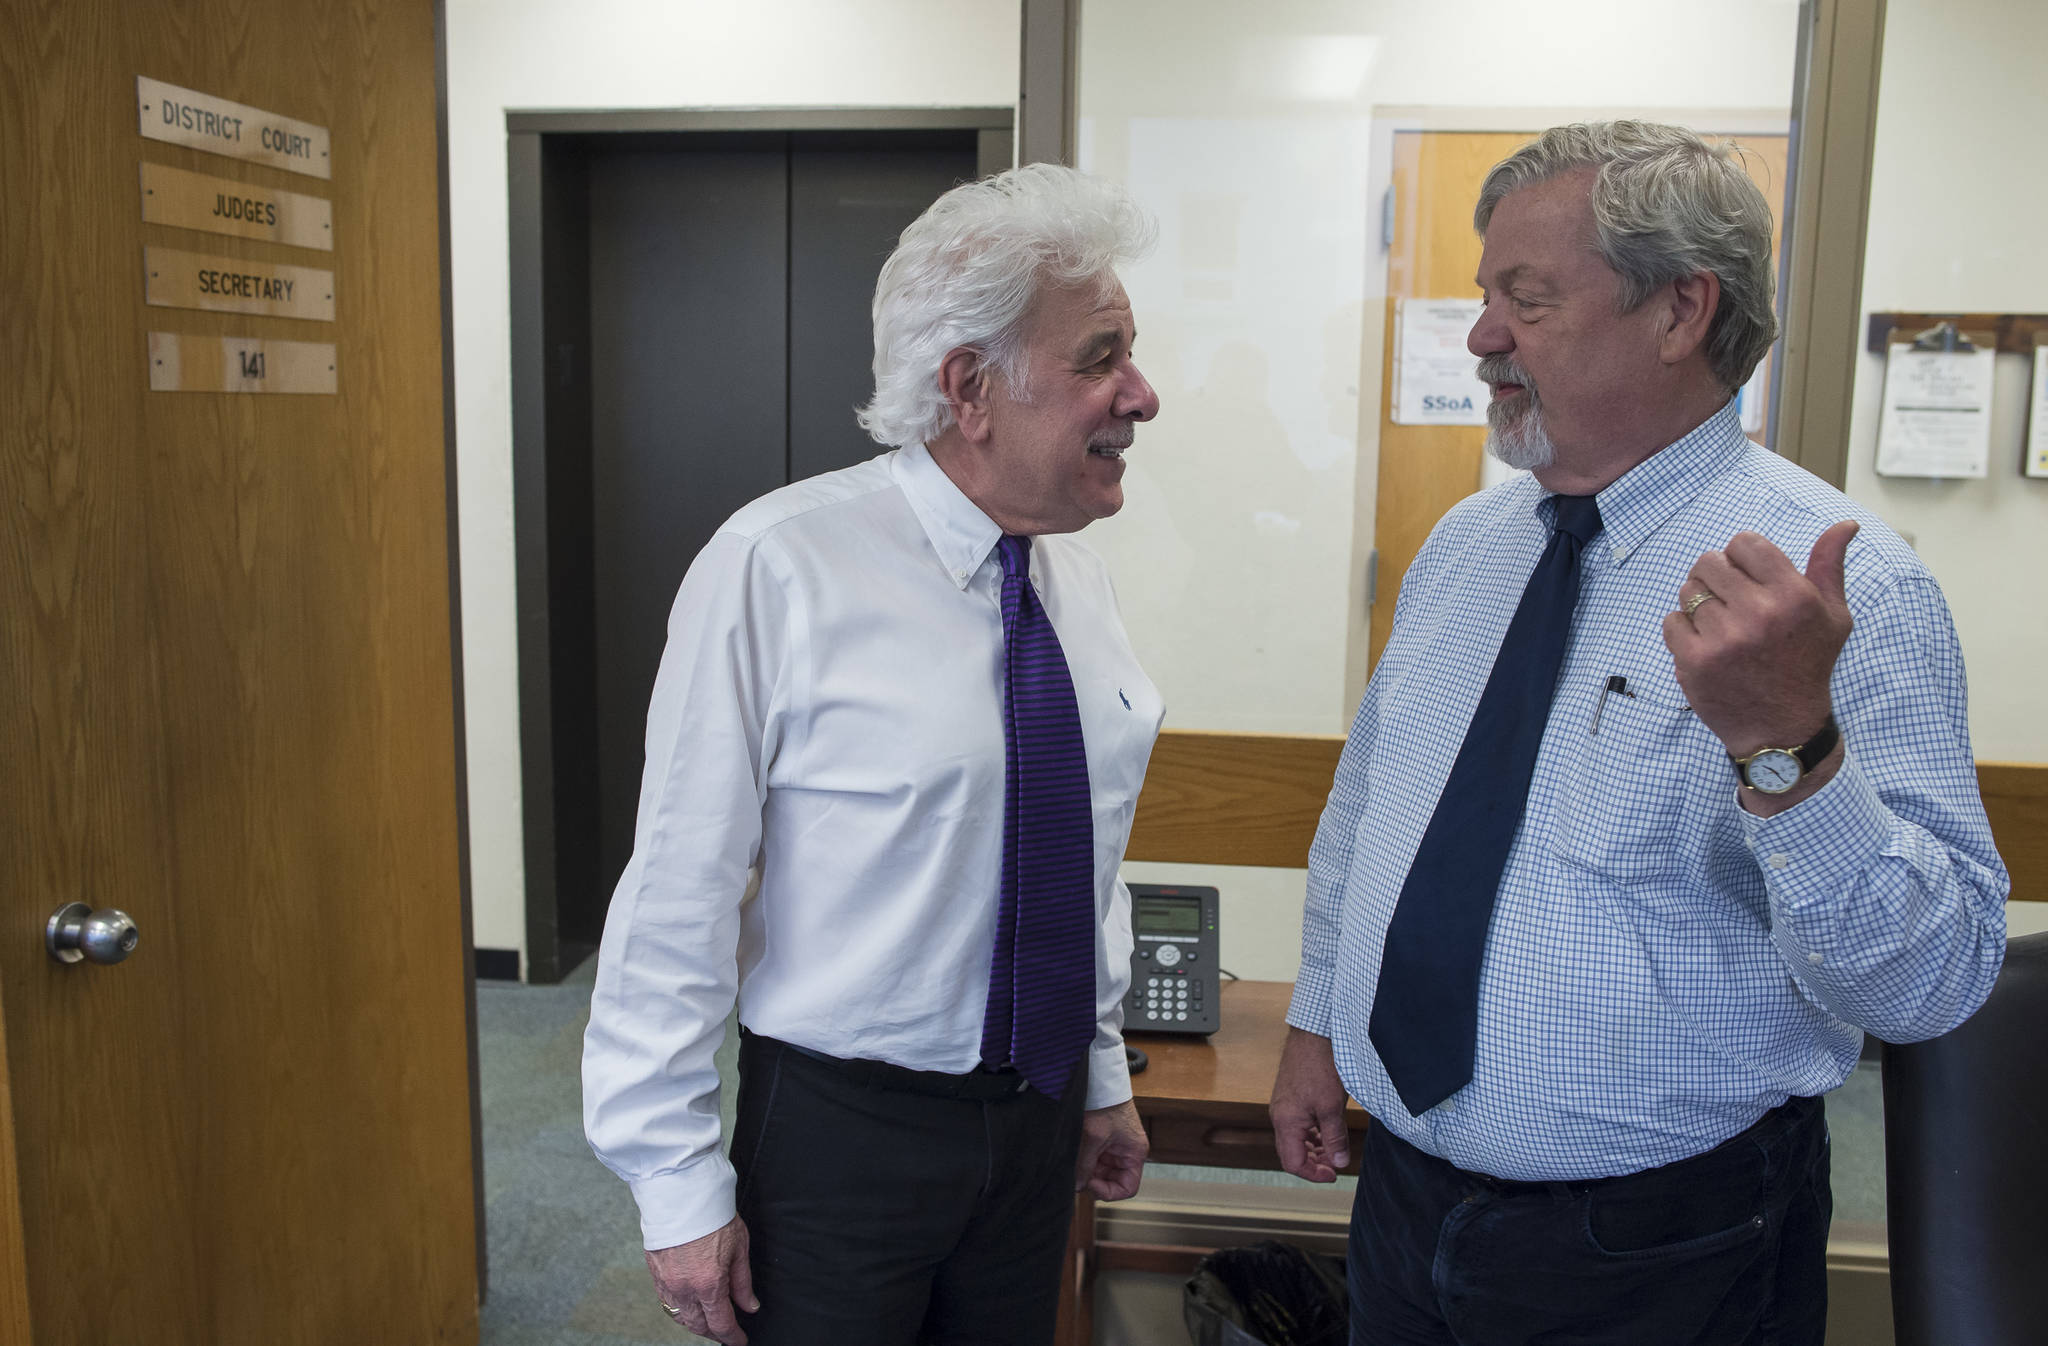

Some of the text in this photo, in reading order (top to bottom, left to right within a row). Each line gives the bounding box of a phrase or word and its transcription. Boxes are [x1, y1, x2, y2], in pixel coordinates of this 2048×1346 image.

[163, 100, 312, 159] DISTRICT COURT
[212, 193, 276, 226] JUDGES
[198, 269, 294, 301] SECRETARY
[240, 350, 266, 379] 141
[1422, 395, 1473, 411] SSoA
